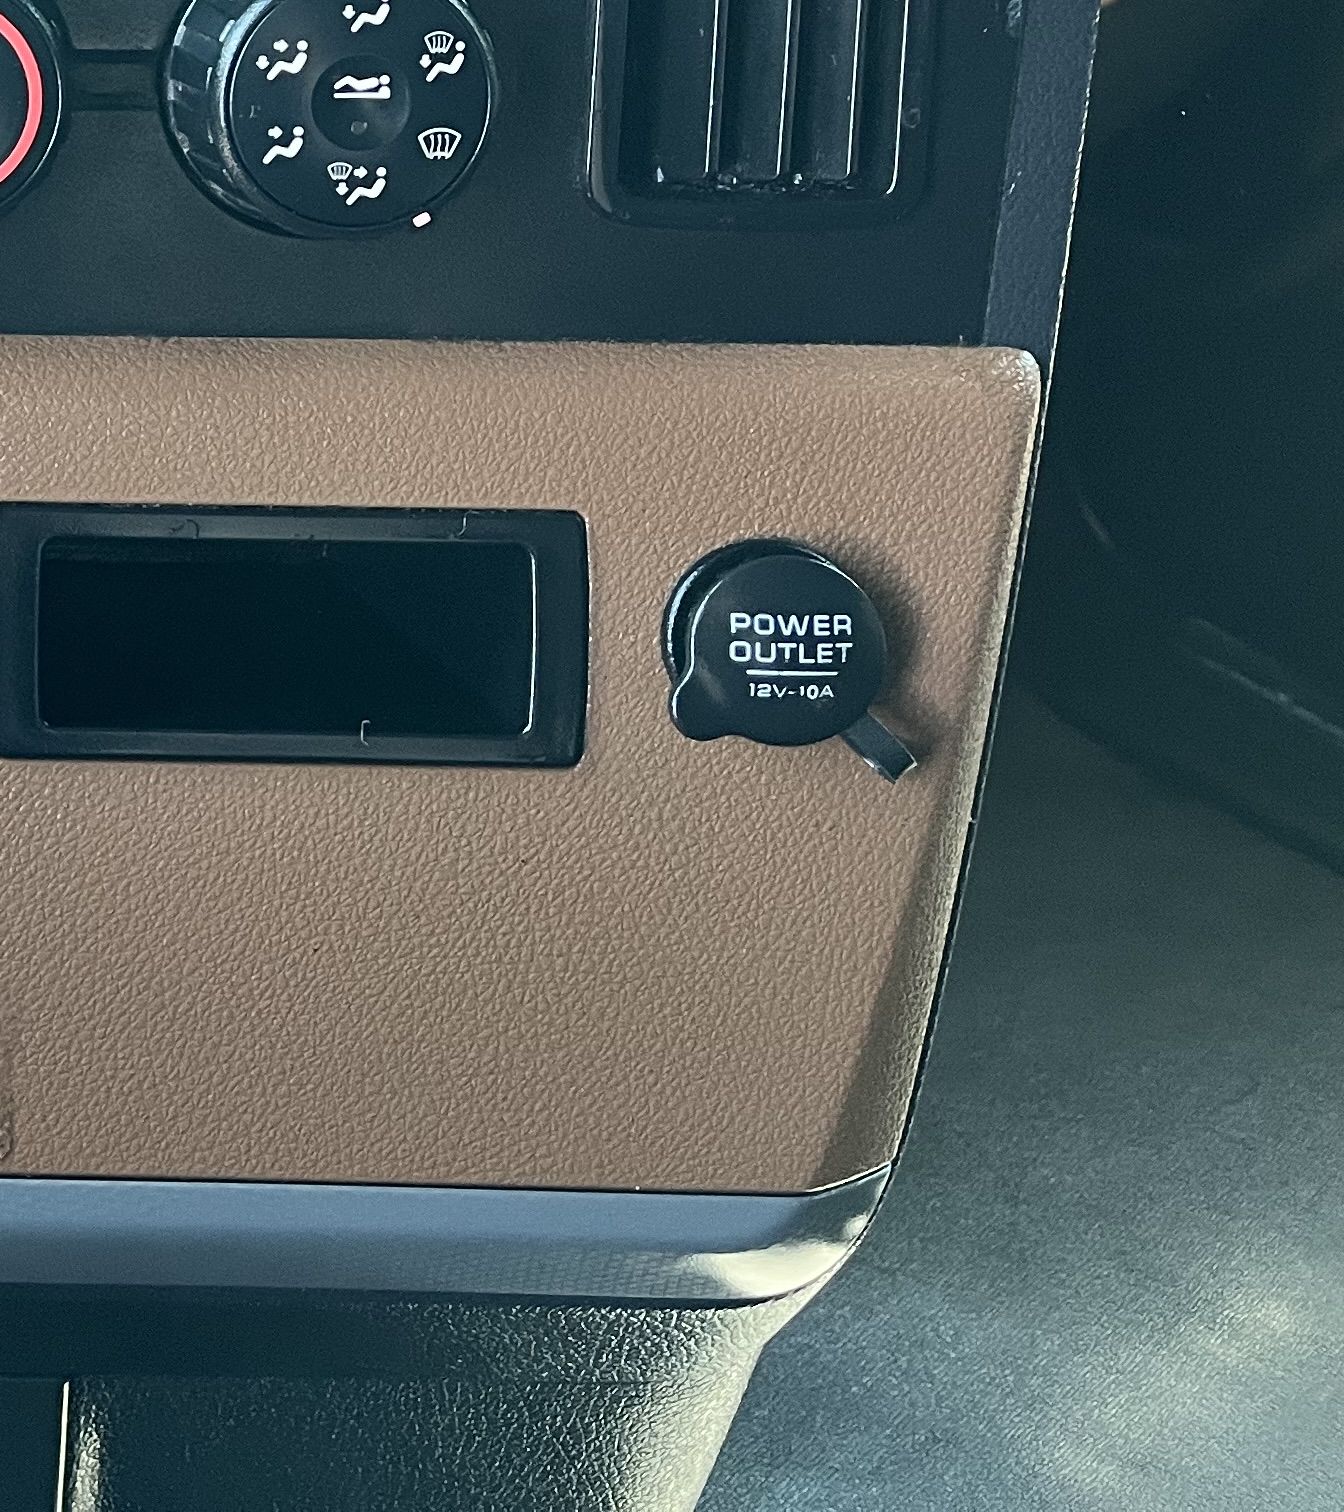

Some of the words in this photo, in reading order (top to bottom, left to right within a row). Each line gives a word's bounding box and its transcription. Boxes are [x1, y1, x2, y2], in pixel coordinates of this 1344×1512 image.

[730, 613, 851, 636] POWER
[729, 641, 853, 663] OUTLET
[749, 683, 834, 699] 12V-10A
